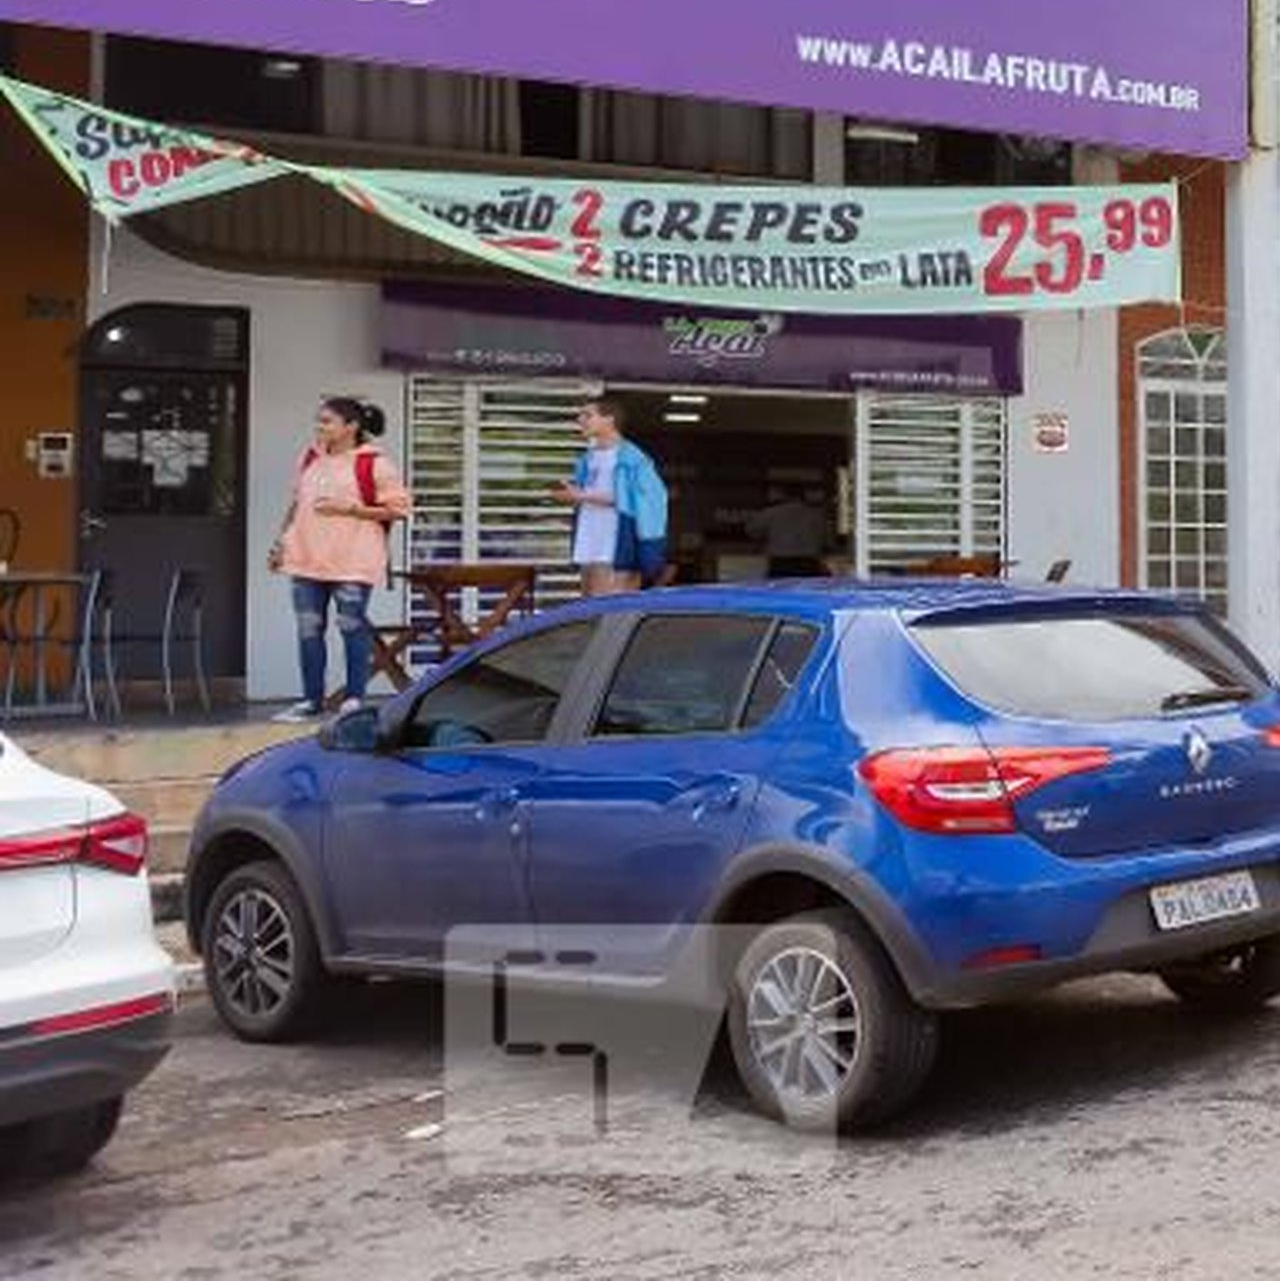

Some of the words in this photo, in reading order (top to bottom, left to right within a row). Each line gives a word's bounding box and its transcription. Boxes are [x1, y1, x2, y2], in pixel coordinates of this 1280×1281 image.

[570, 188, 606, 242] 2
[620, 197, 865, 246] CREPES
[979, 195, 1174, 297] 25,99
[573, 240, 604, 280] 2
[613, 248, 856, 292] REFRIGERANTES
[898, 249, 975, 290] LATA
